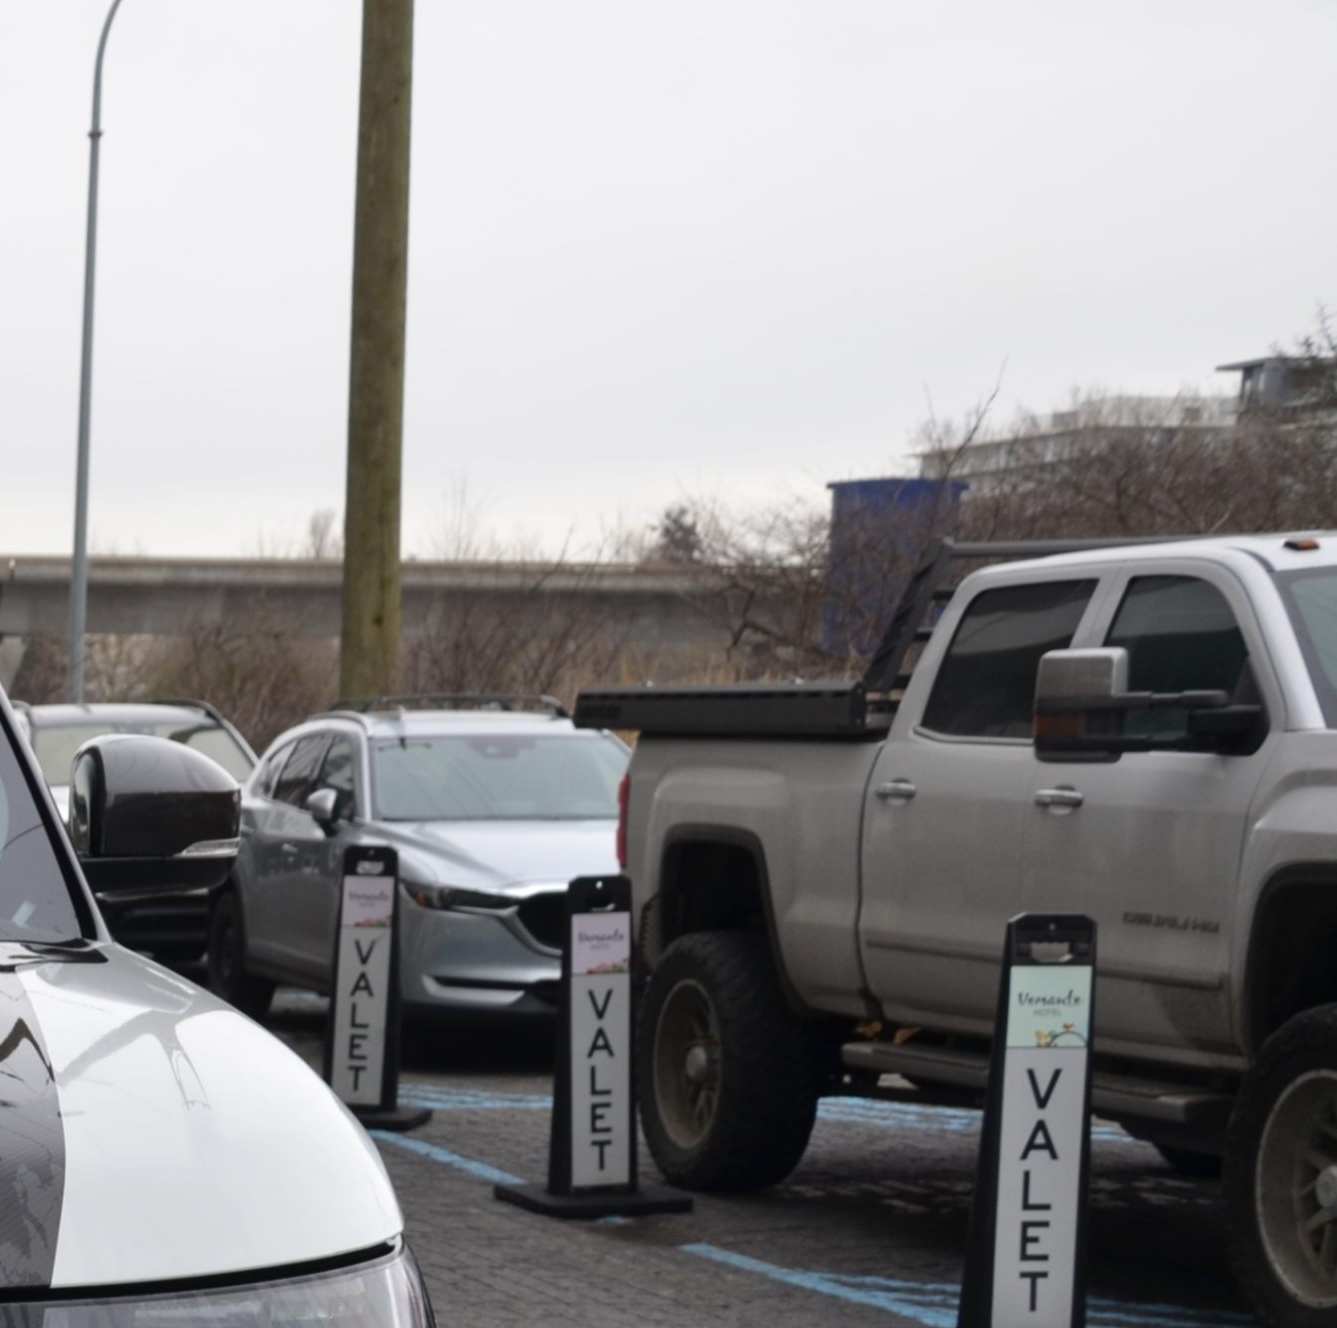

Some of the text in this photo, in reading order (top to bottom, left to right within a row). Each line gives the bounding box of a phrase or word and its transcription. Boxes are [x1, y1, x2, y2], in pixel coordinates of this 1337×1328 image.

[348, 938, 377, 1092] VALET
[587, 988, 615, 1172] VALET
[1017, 989, 1083, 1007] Versante
[1019, 1068, 1063, 1313] VALET
